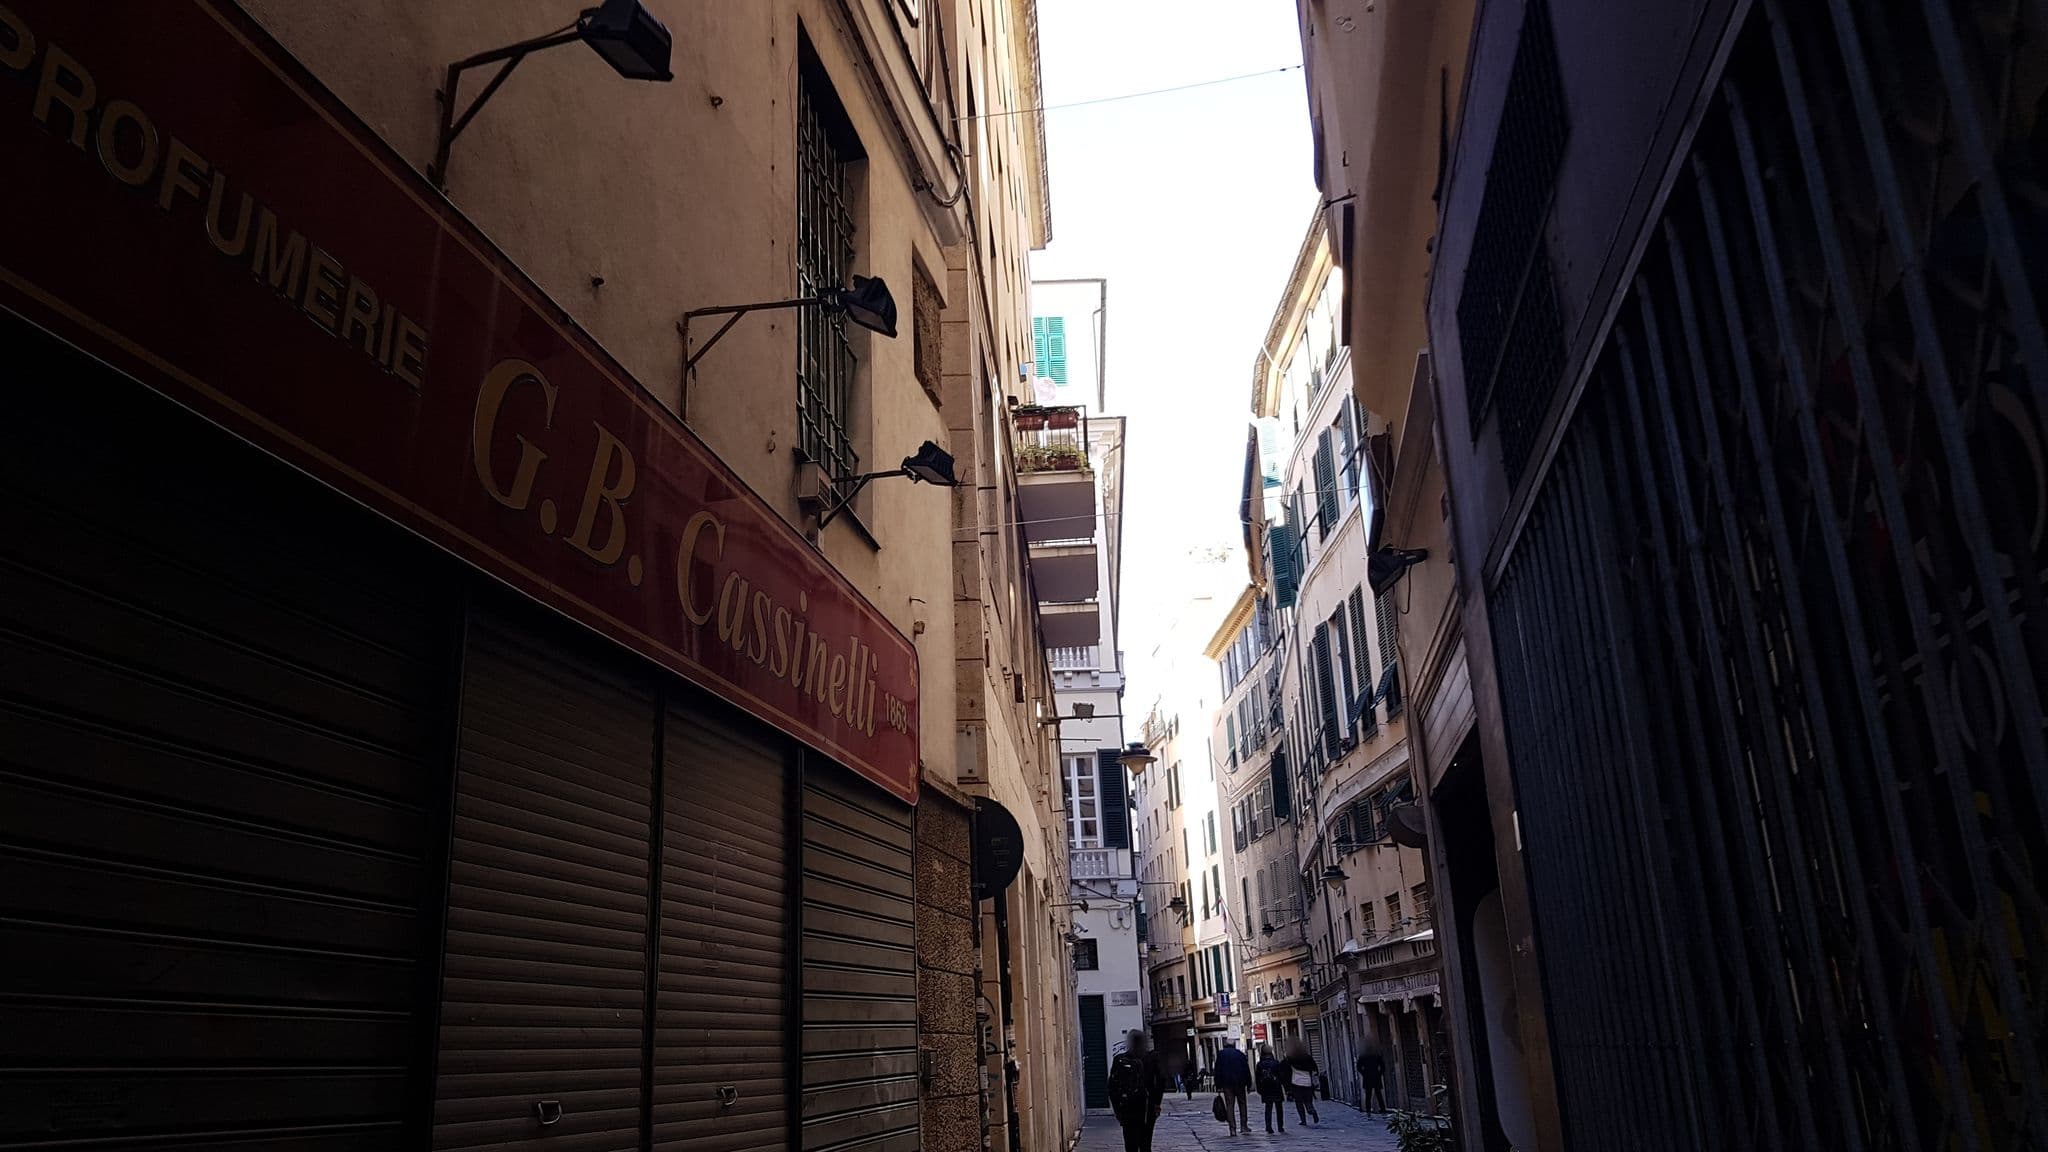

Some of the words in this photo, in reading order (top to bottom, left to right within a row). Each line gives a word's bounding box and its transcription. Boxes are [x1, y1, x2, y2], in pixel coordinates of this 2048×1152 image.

[473, 358, 643, 587] G.B.
[677, 511, 879, 738] Cassinelli
[885, 692, 907, 735] 1863
